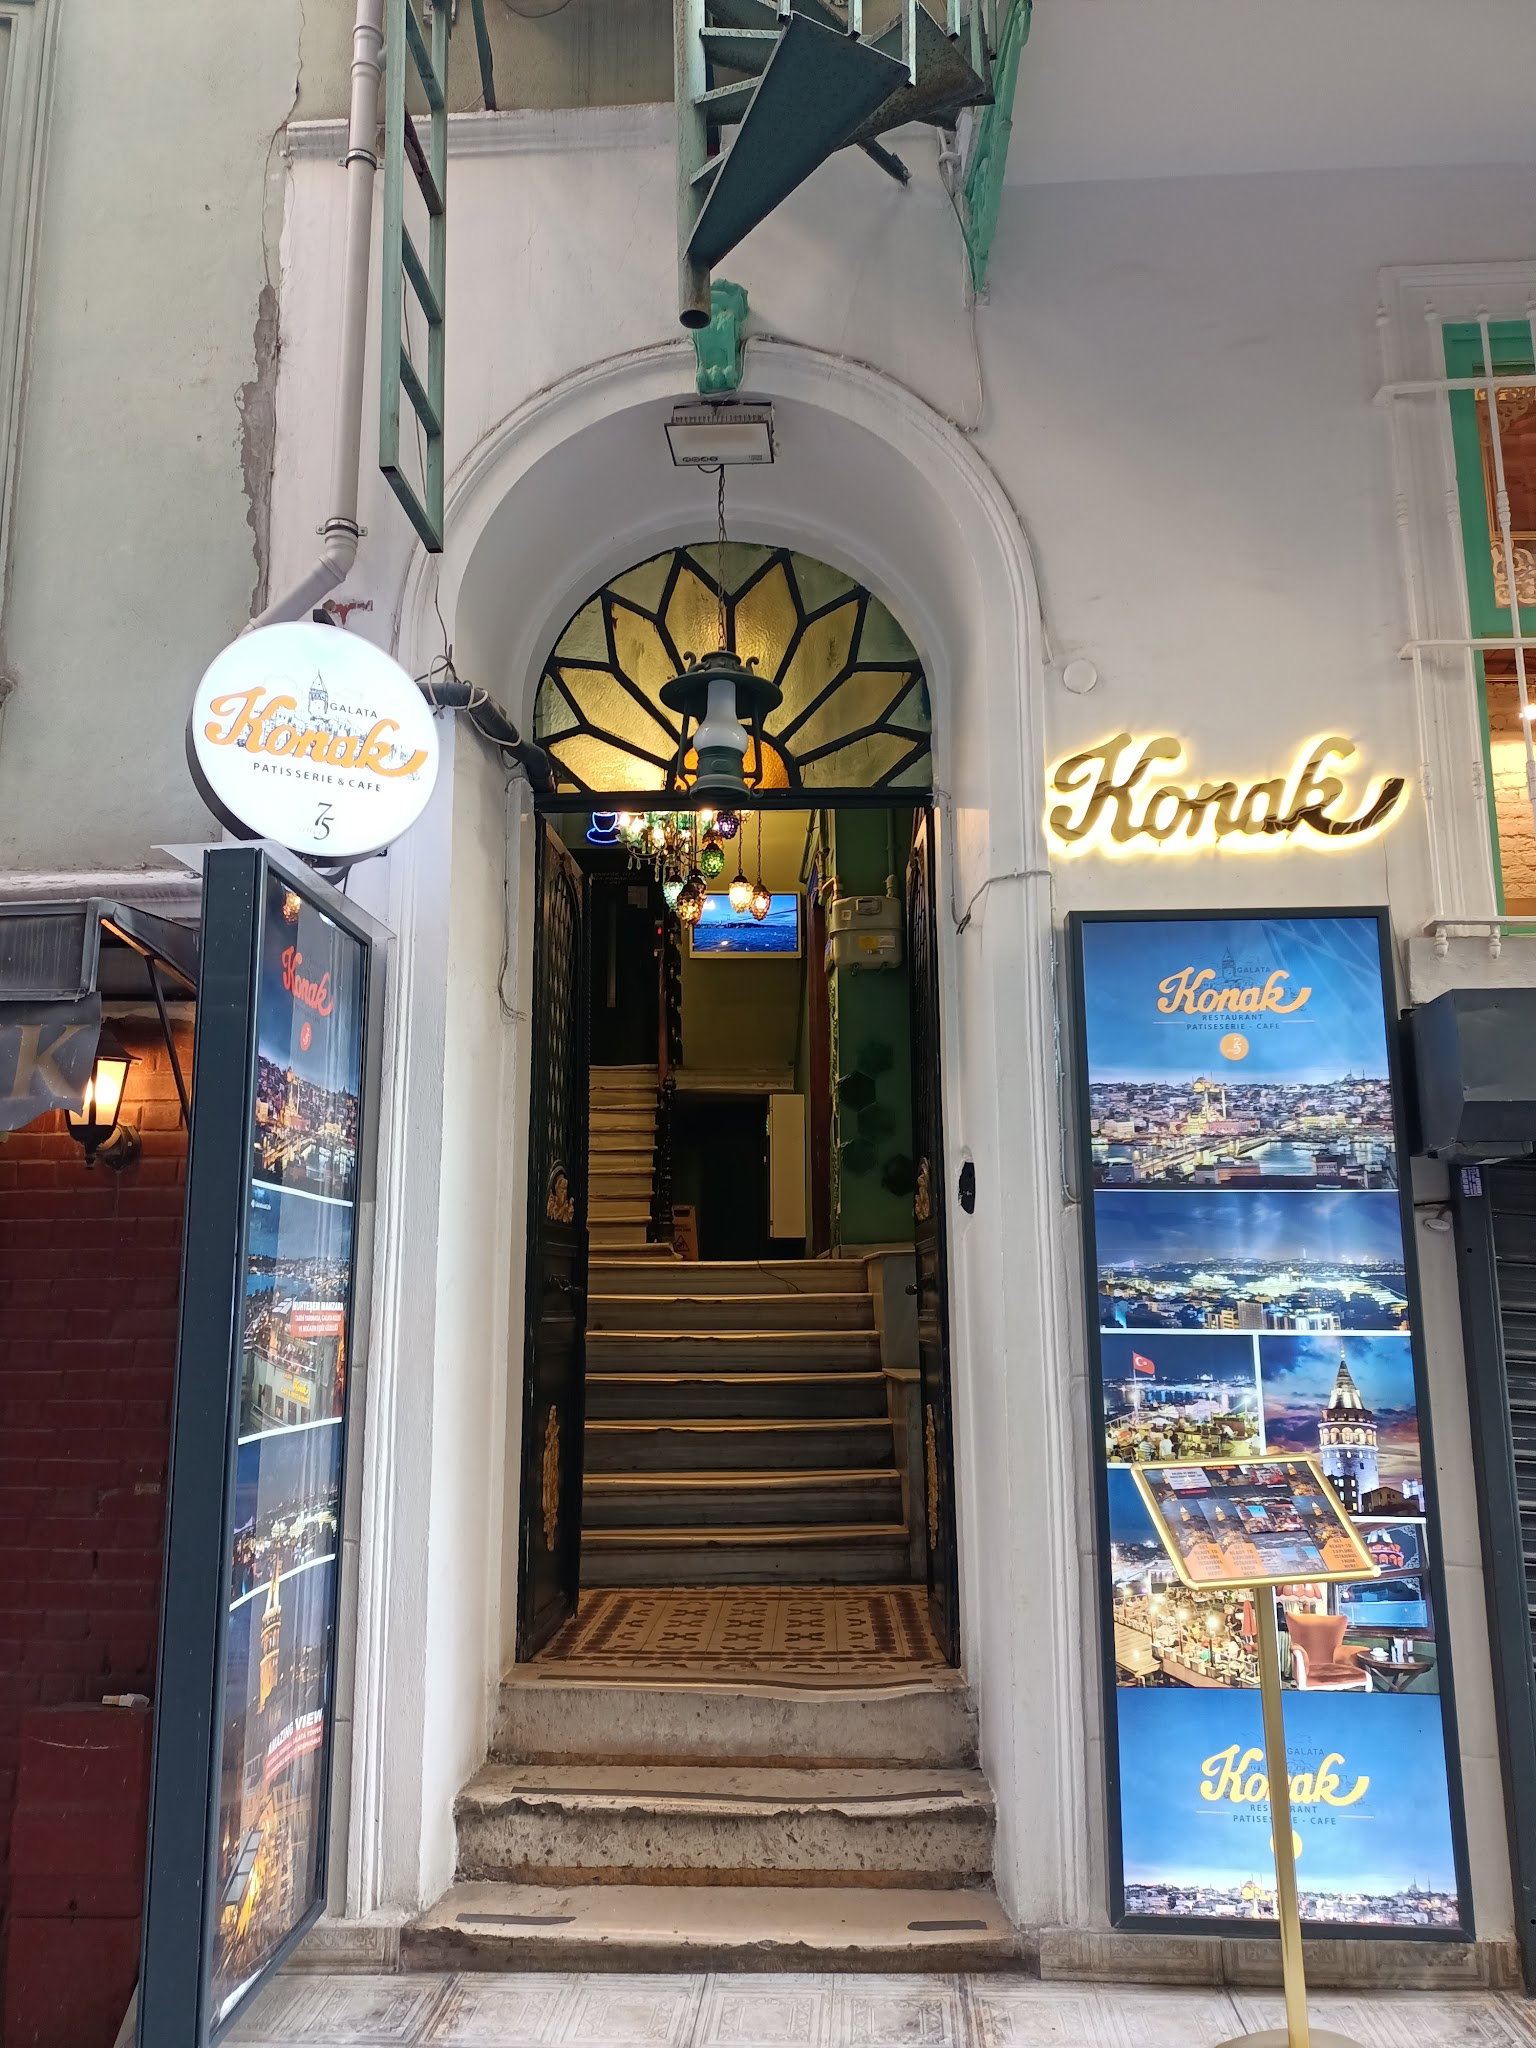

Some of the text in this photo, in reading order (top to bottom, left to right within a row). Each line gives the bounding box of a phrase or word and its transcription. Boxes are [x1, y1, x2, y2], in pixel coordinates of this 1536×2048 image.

[329, 702, 378, 719] GALATA
[204, 686, 429, 777] Konak
[253, 762, 382, 792] PATISSERIE & CAFE
[1050, 732, 1405, 843] Konak
[281, 944, 335, 1017] Konak
[1236, 966, 1271, 974] GALATA
[1156, 966, 1312, 1014] Konak
[268, 1721, 294, 1757] AMAZING
[295, 1707, 323, 1731] VIEW
[1286, 1748, 1325, 1756] GALATA
[1250, 1804, 1317, 1813] RESRANT
[1310, 1817, 1337, 1825] CAFE
